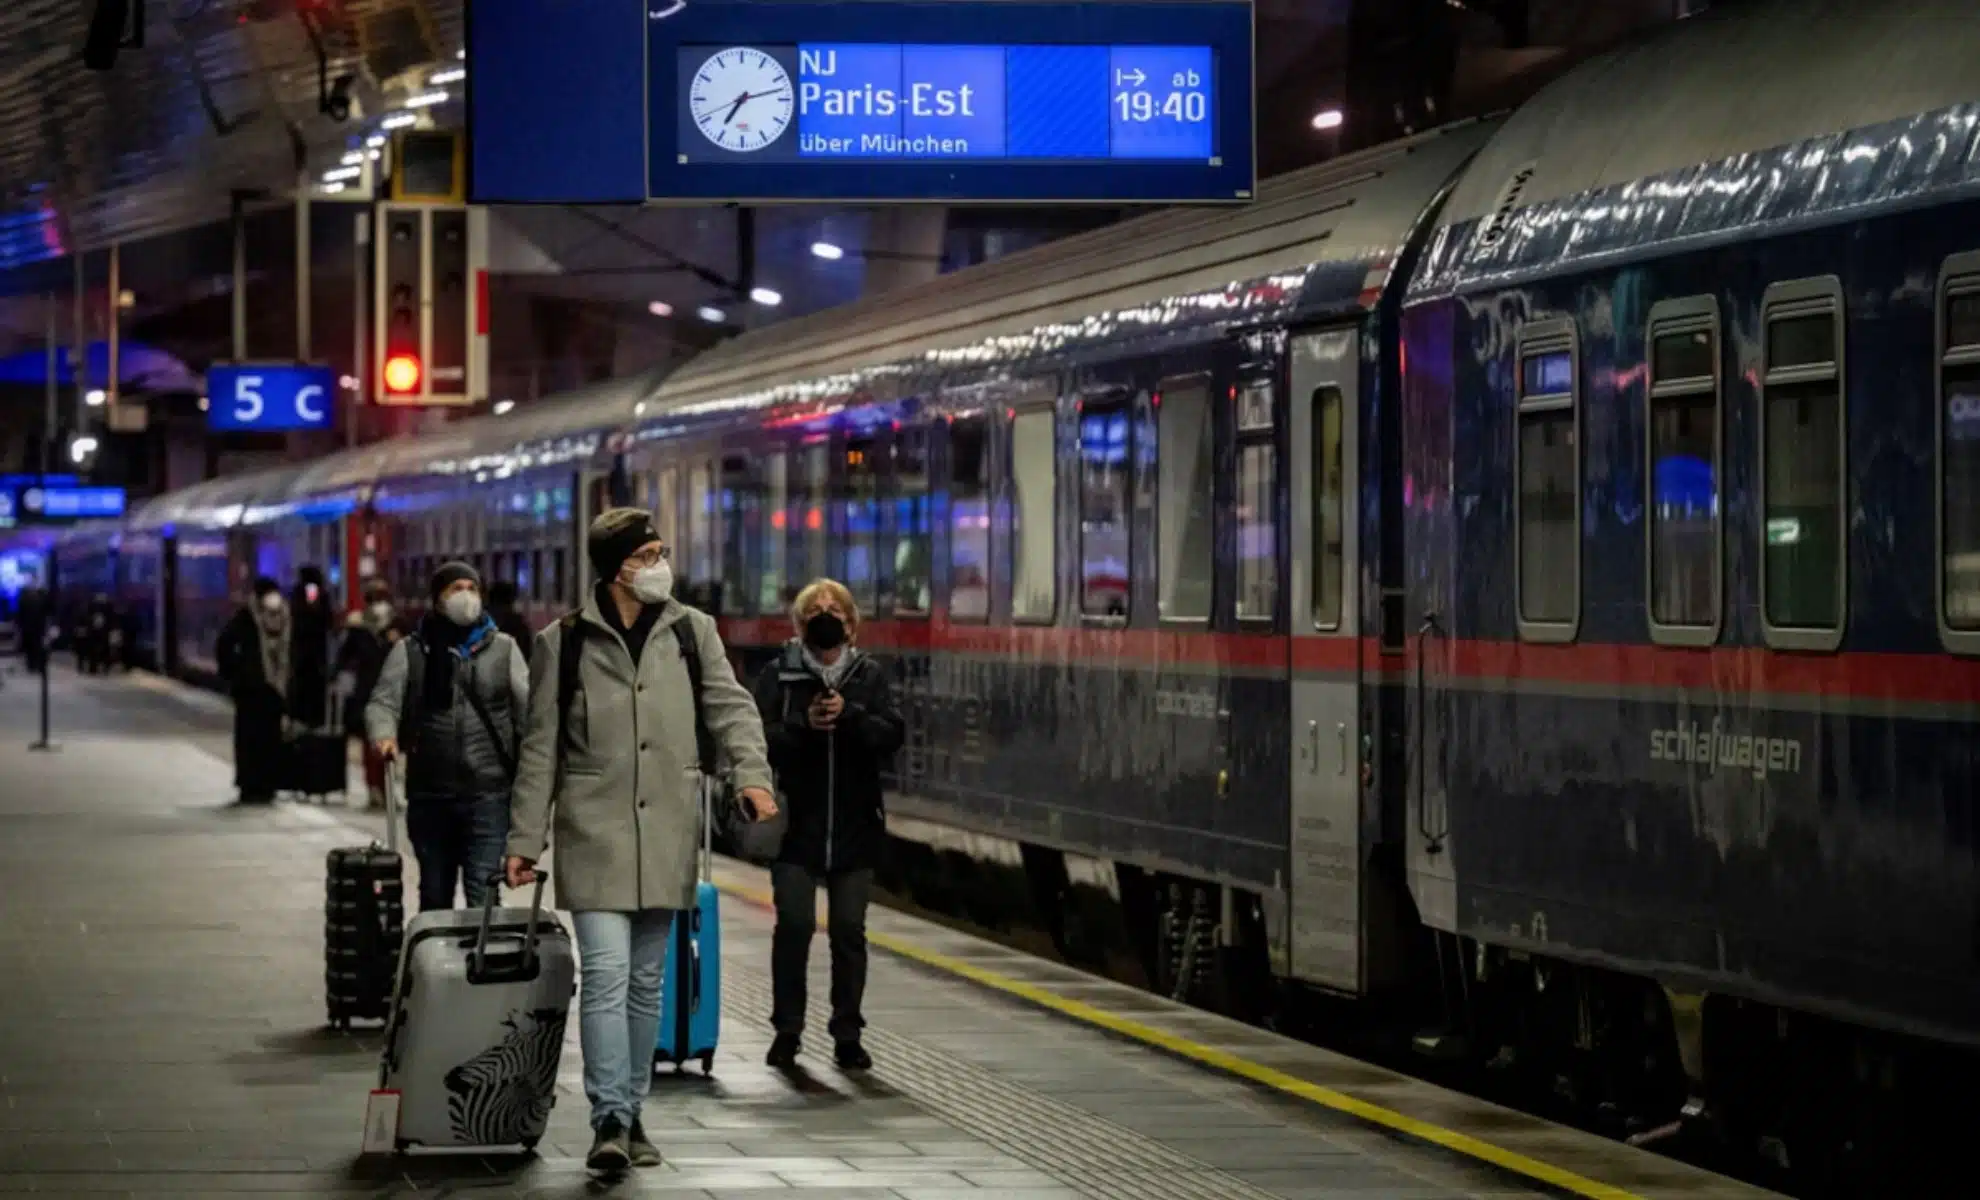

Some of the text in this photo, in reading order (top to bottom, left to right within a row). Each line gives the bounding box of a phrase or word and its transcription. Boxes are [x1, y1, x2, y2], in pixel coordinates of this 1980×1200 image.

[800, 50, 836, 76] NJ
[1172, 68, 1200, 87] ab
[800, 82, 974, 116] Paris-Est
[1115, 91, 1205, 121] 19:40
[800, 133, 968, 153] über München
[235, 376, 263, 421] 5
[1651, 716, 1800, 780] schlafwagen
